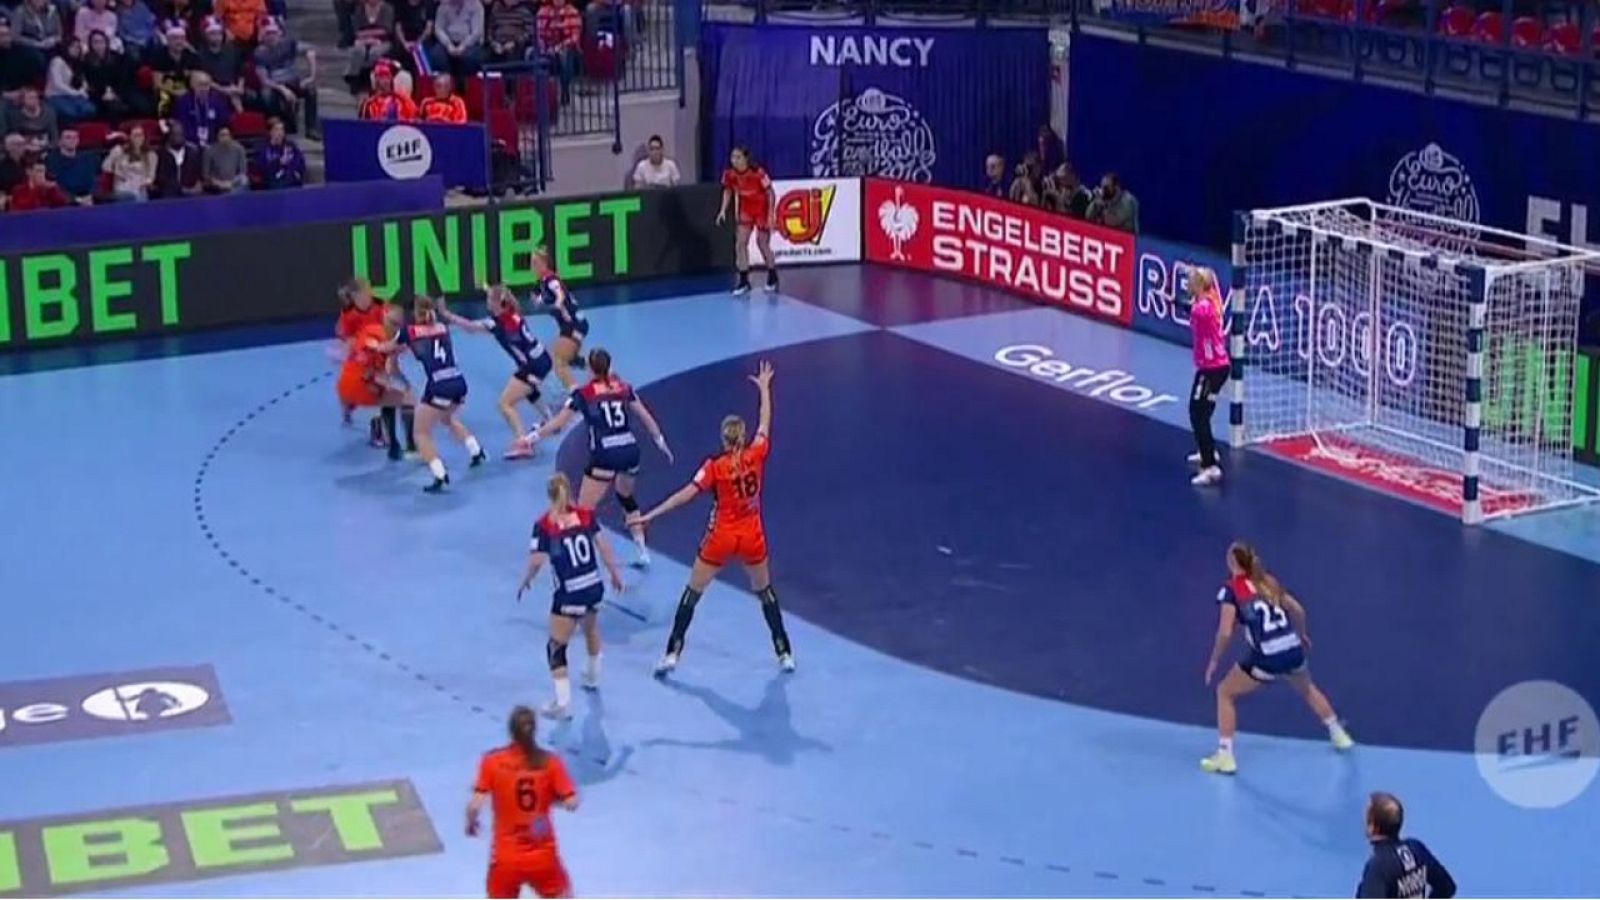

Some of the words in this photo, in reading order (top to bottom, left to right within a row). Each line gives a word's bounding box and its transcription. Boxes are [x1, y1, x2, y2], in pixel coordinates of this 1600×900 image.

[809, 35, 934, 66] NANCY
[386, 137, 421, 159] EHF
[351, 197, 641, 300] UNIBET
[933, 201, 1124, 274] ENGELBERT
[933, 235, 1122, 316] STRAUSS
[434, 339, 446, 364] 4
[1295, 295, 1417, 386] 1000
[994, 344, 1179, 408] Gerflor
[601, 401, 626, 428] 13
[732, 471, 759, 499] 18
[563, 534, 591, 567] 10
[1254, 600, 1288, 632] 23
[516, 777, 537, 812] 6
